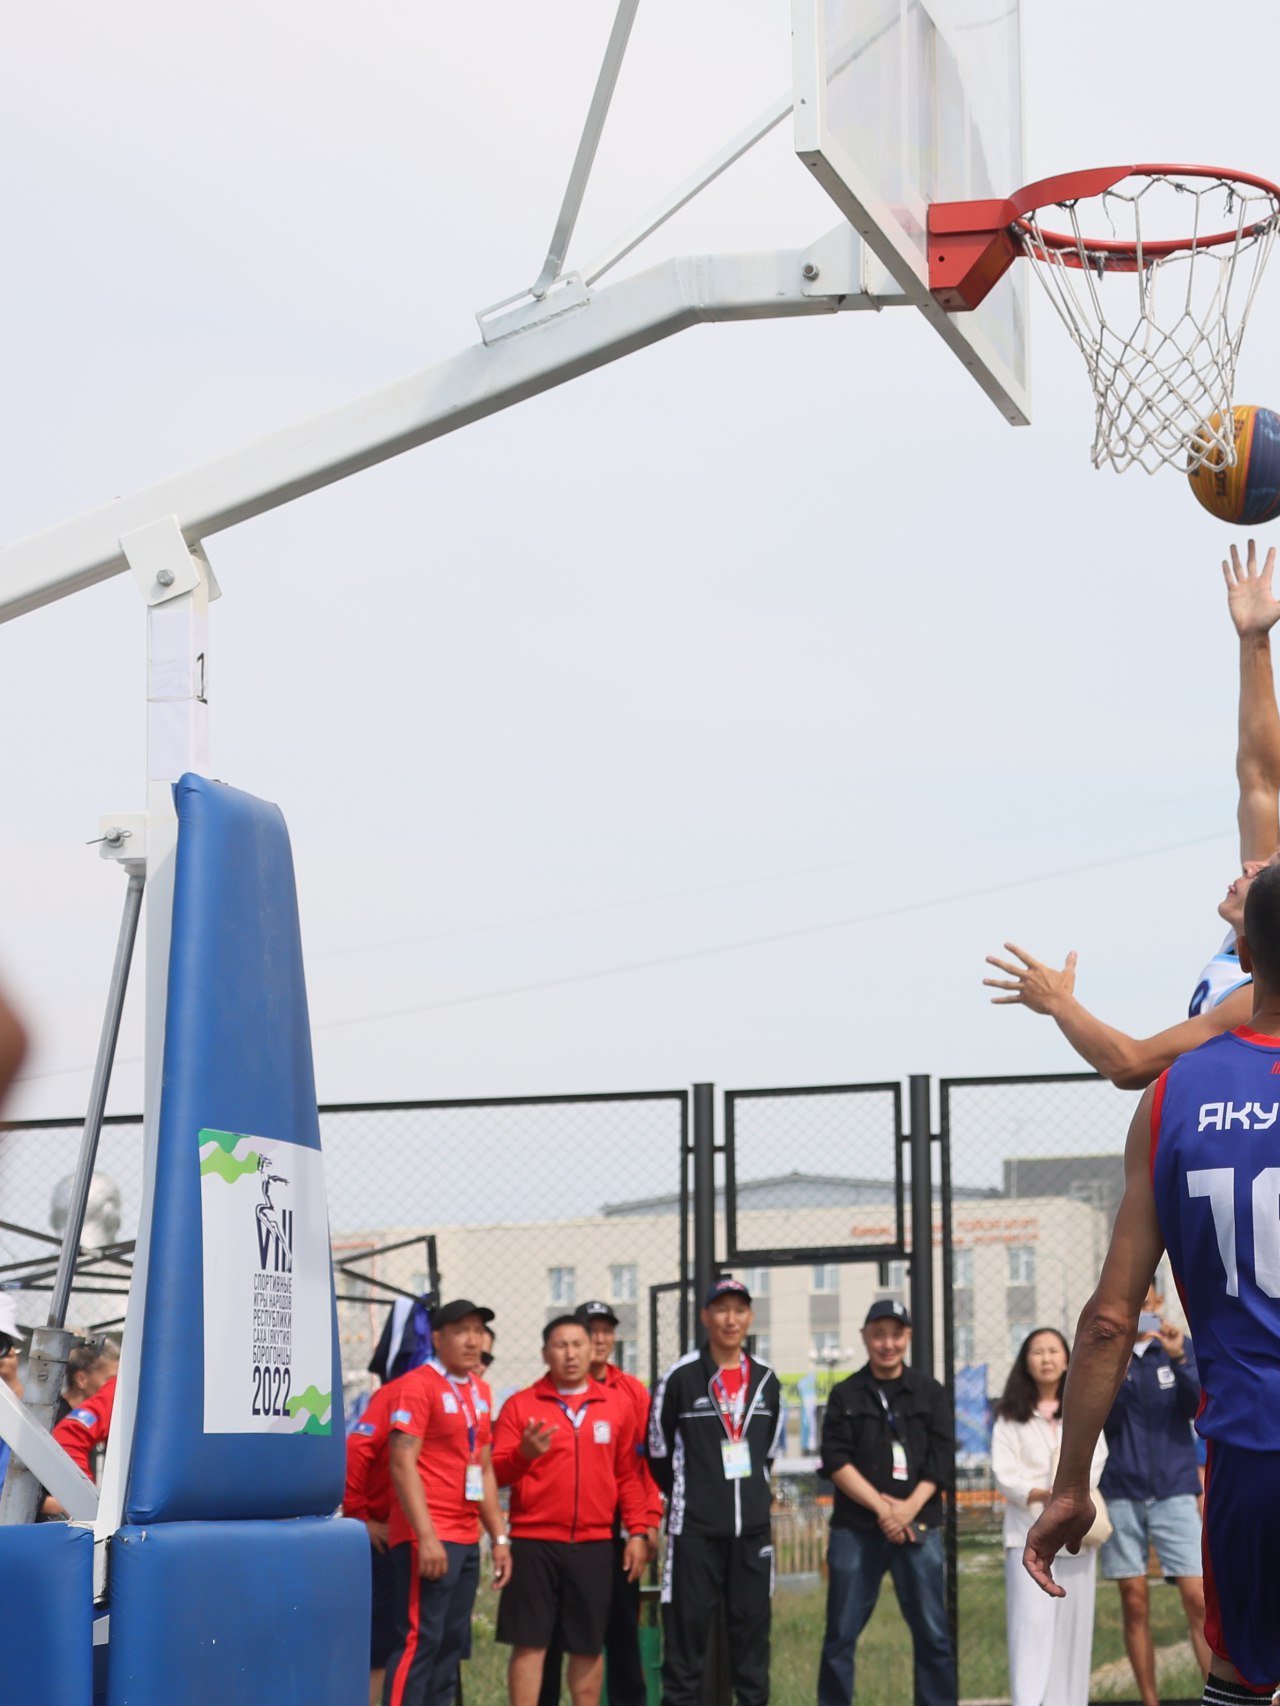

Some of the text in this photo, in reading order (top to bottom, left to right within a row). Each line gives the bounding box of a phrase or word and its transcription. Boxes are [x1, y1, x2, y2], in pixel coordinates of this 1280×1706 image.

[196, 652, 208, 705] 1
[253, 1273, 292, 1295] СПОРТИВНЫЕ
[253, 1292, 292, 1311] ИГРЫ НАРОДОВ
[253, 1309, 292, 1330] РЕСПУБЛИКИ
[253, 1327, 267, 1344] САХА
[252, 1345, 292, 1366] БОРОГОНЦЫ
[252, 1366, 291, 1417] 2022
